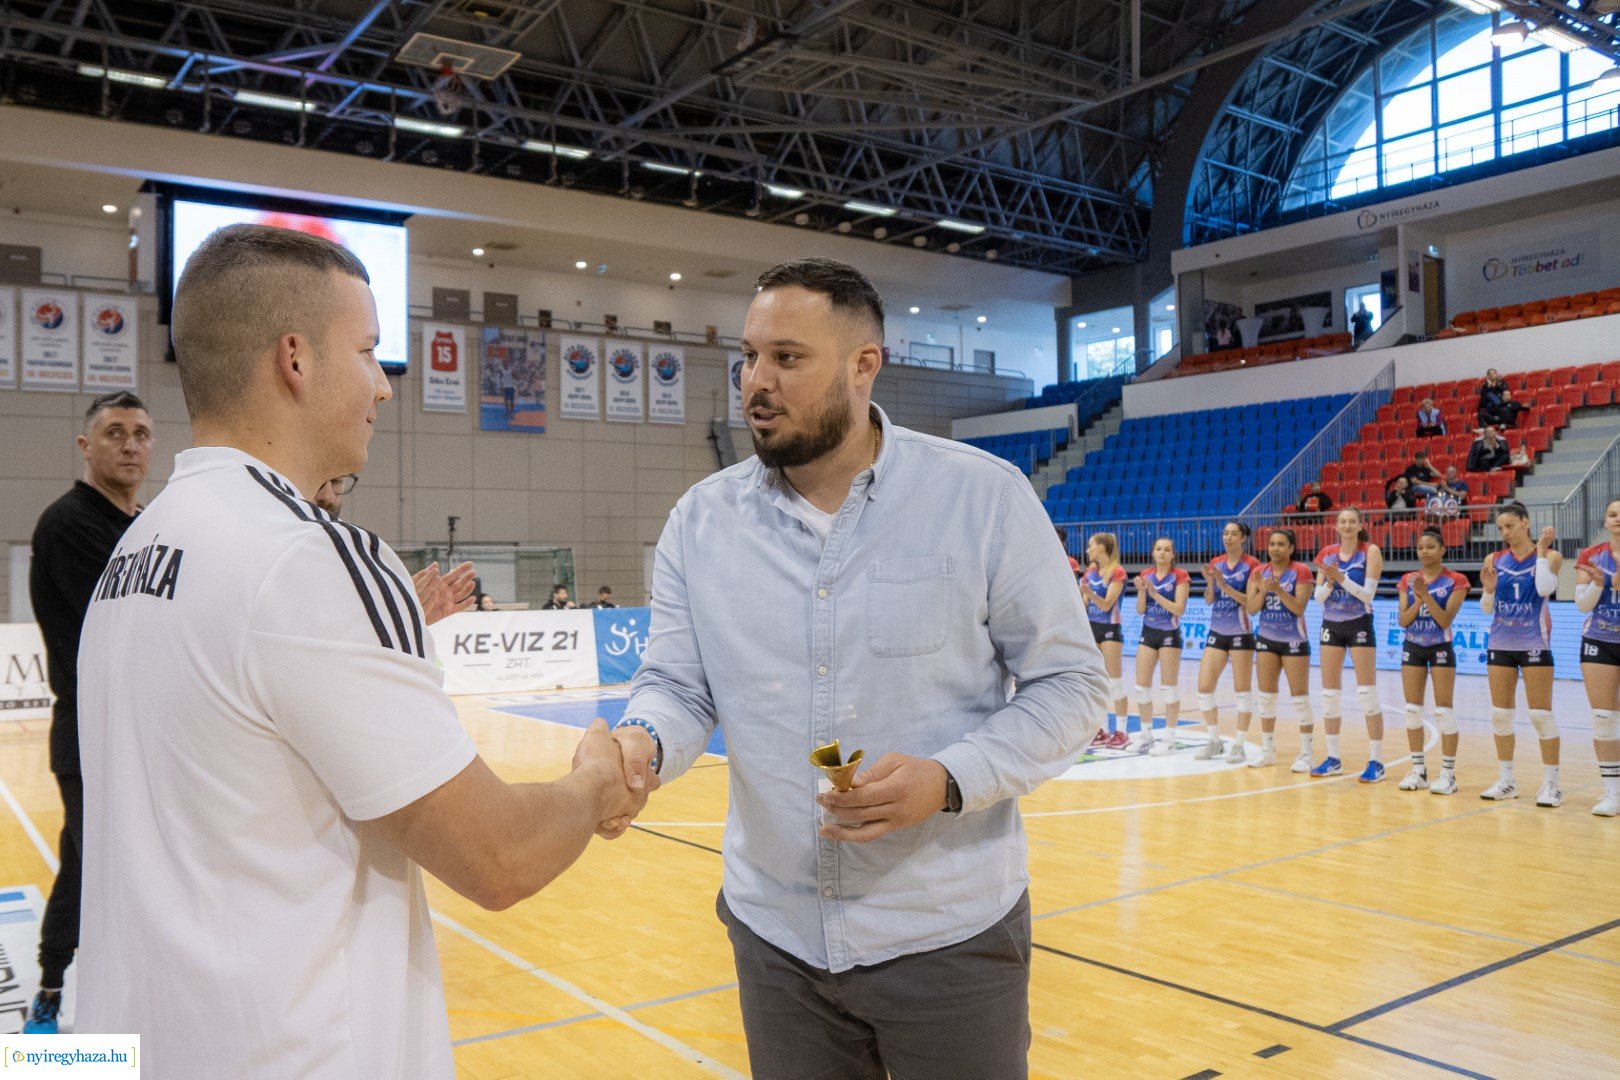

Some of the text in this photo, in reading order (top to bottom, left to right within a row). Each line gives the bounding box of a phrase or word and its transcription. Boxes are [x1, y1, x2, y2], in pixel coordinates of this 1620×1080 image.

[437, 345, 452, 364] 15
[1512, 582, 1520, 600] 1
[1265, 595, 1281, 611] 22
[453, 630, 578, 655] KE-VIZ 21
[1584, 643, 1599, 657] 18
